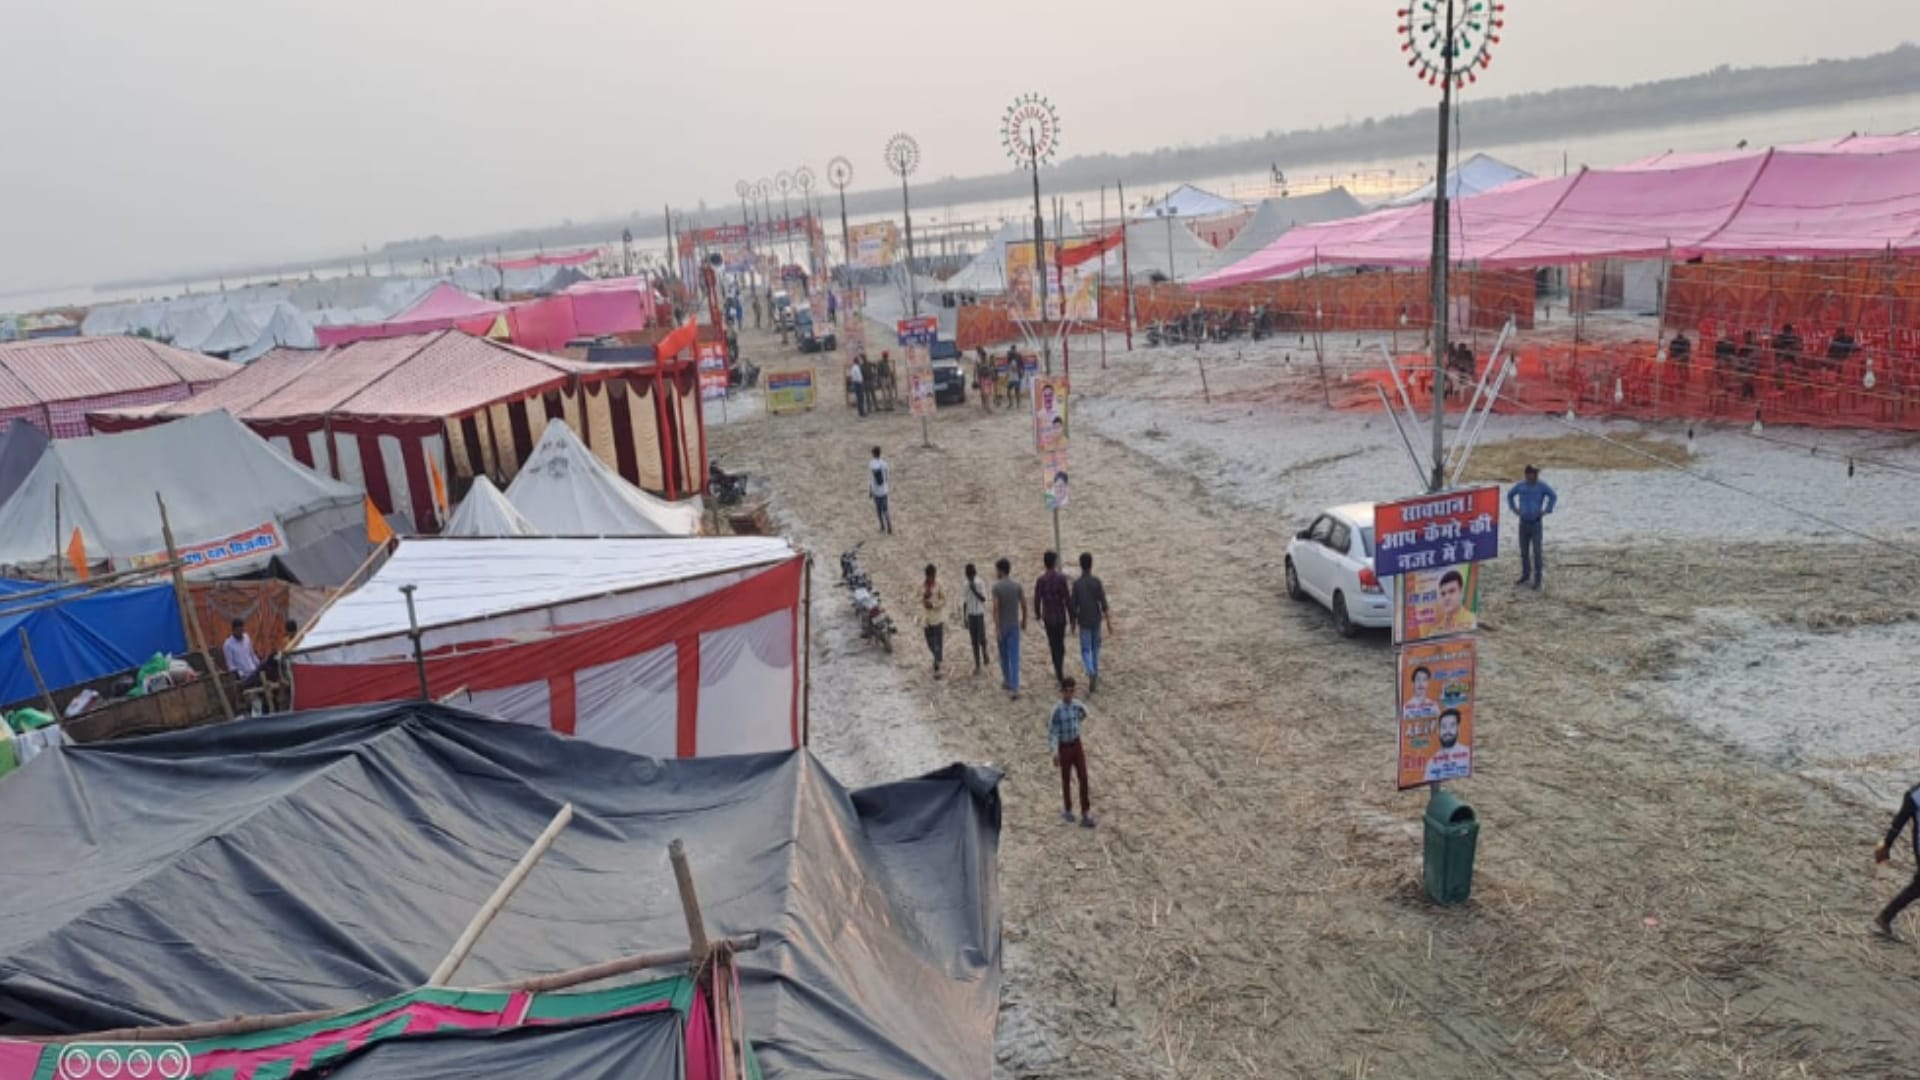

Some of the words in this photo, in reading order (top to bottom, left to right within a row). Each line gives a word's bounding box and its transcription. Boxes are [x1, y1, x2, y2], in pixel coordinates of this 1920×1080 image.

[1381, 529, 1417, 550] आप
[1469, 512, 1492, 535] की
[1441, 540, 1457, 562] में
